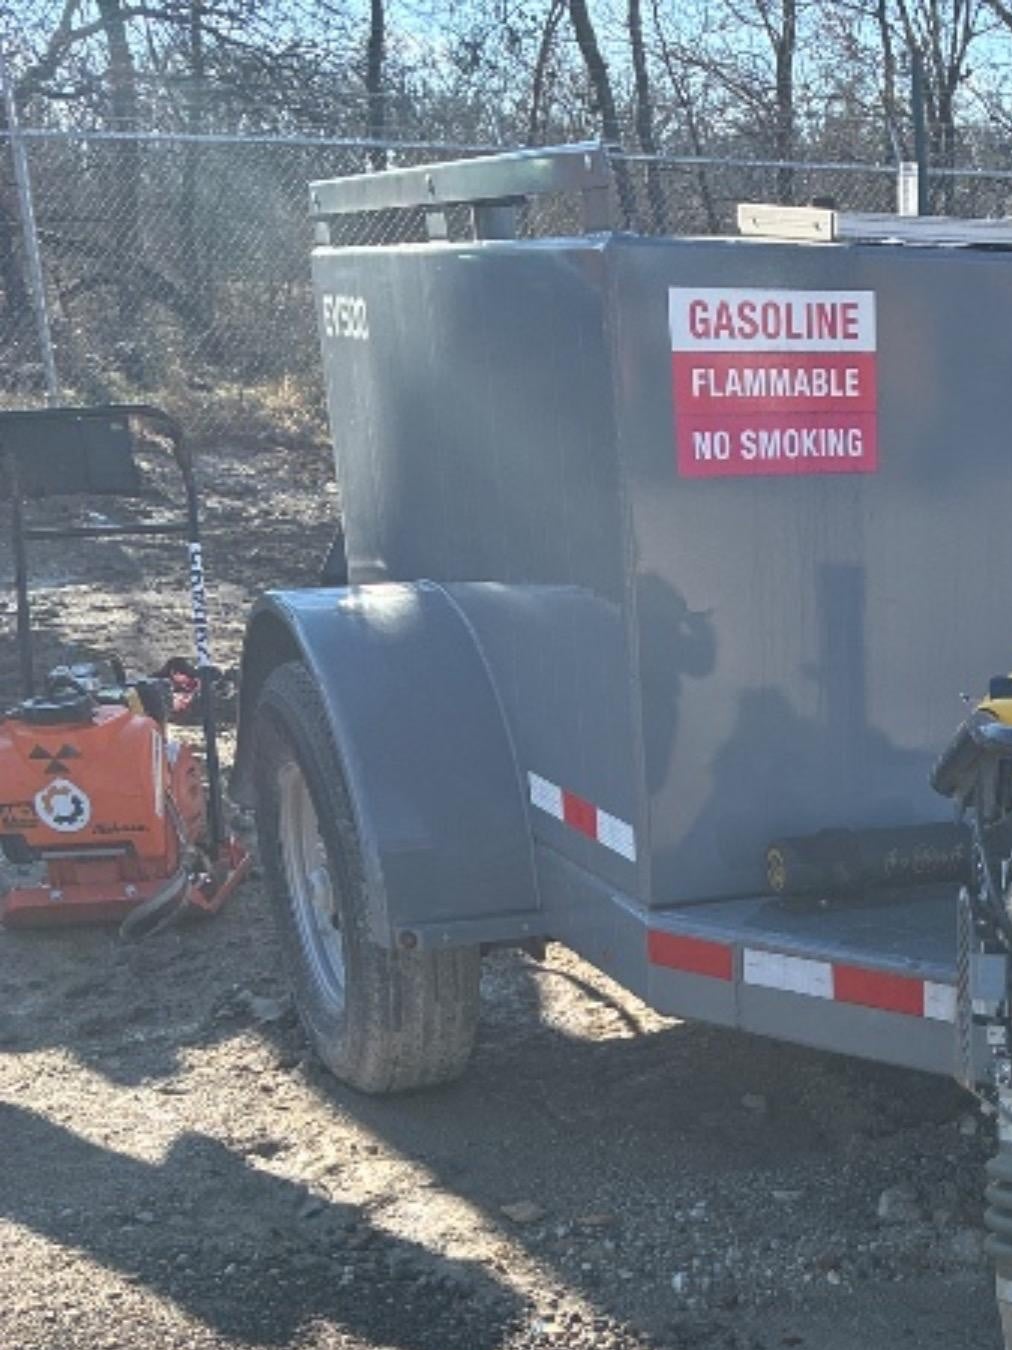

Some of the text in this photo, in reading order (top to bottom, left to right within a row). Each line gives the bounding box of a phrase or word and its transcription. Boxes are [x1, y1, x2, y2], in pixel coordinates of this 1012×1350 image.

[689, 300, 859, 340] GASOLINE
[692, 368, 860, 398] FLAMMABLE
[694, 428, 863, 461] NO SMOKING
